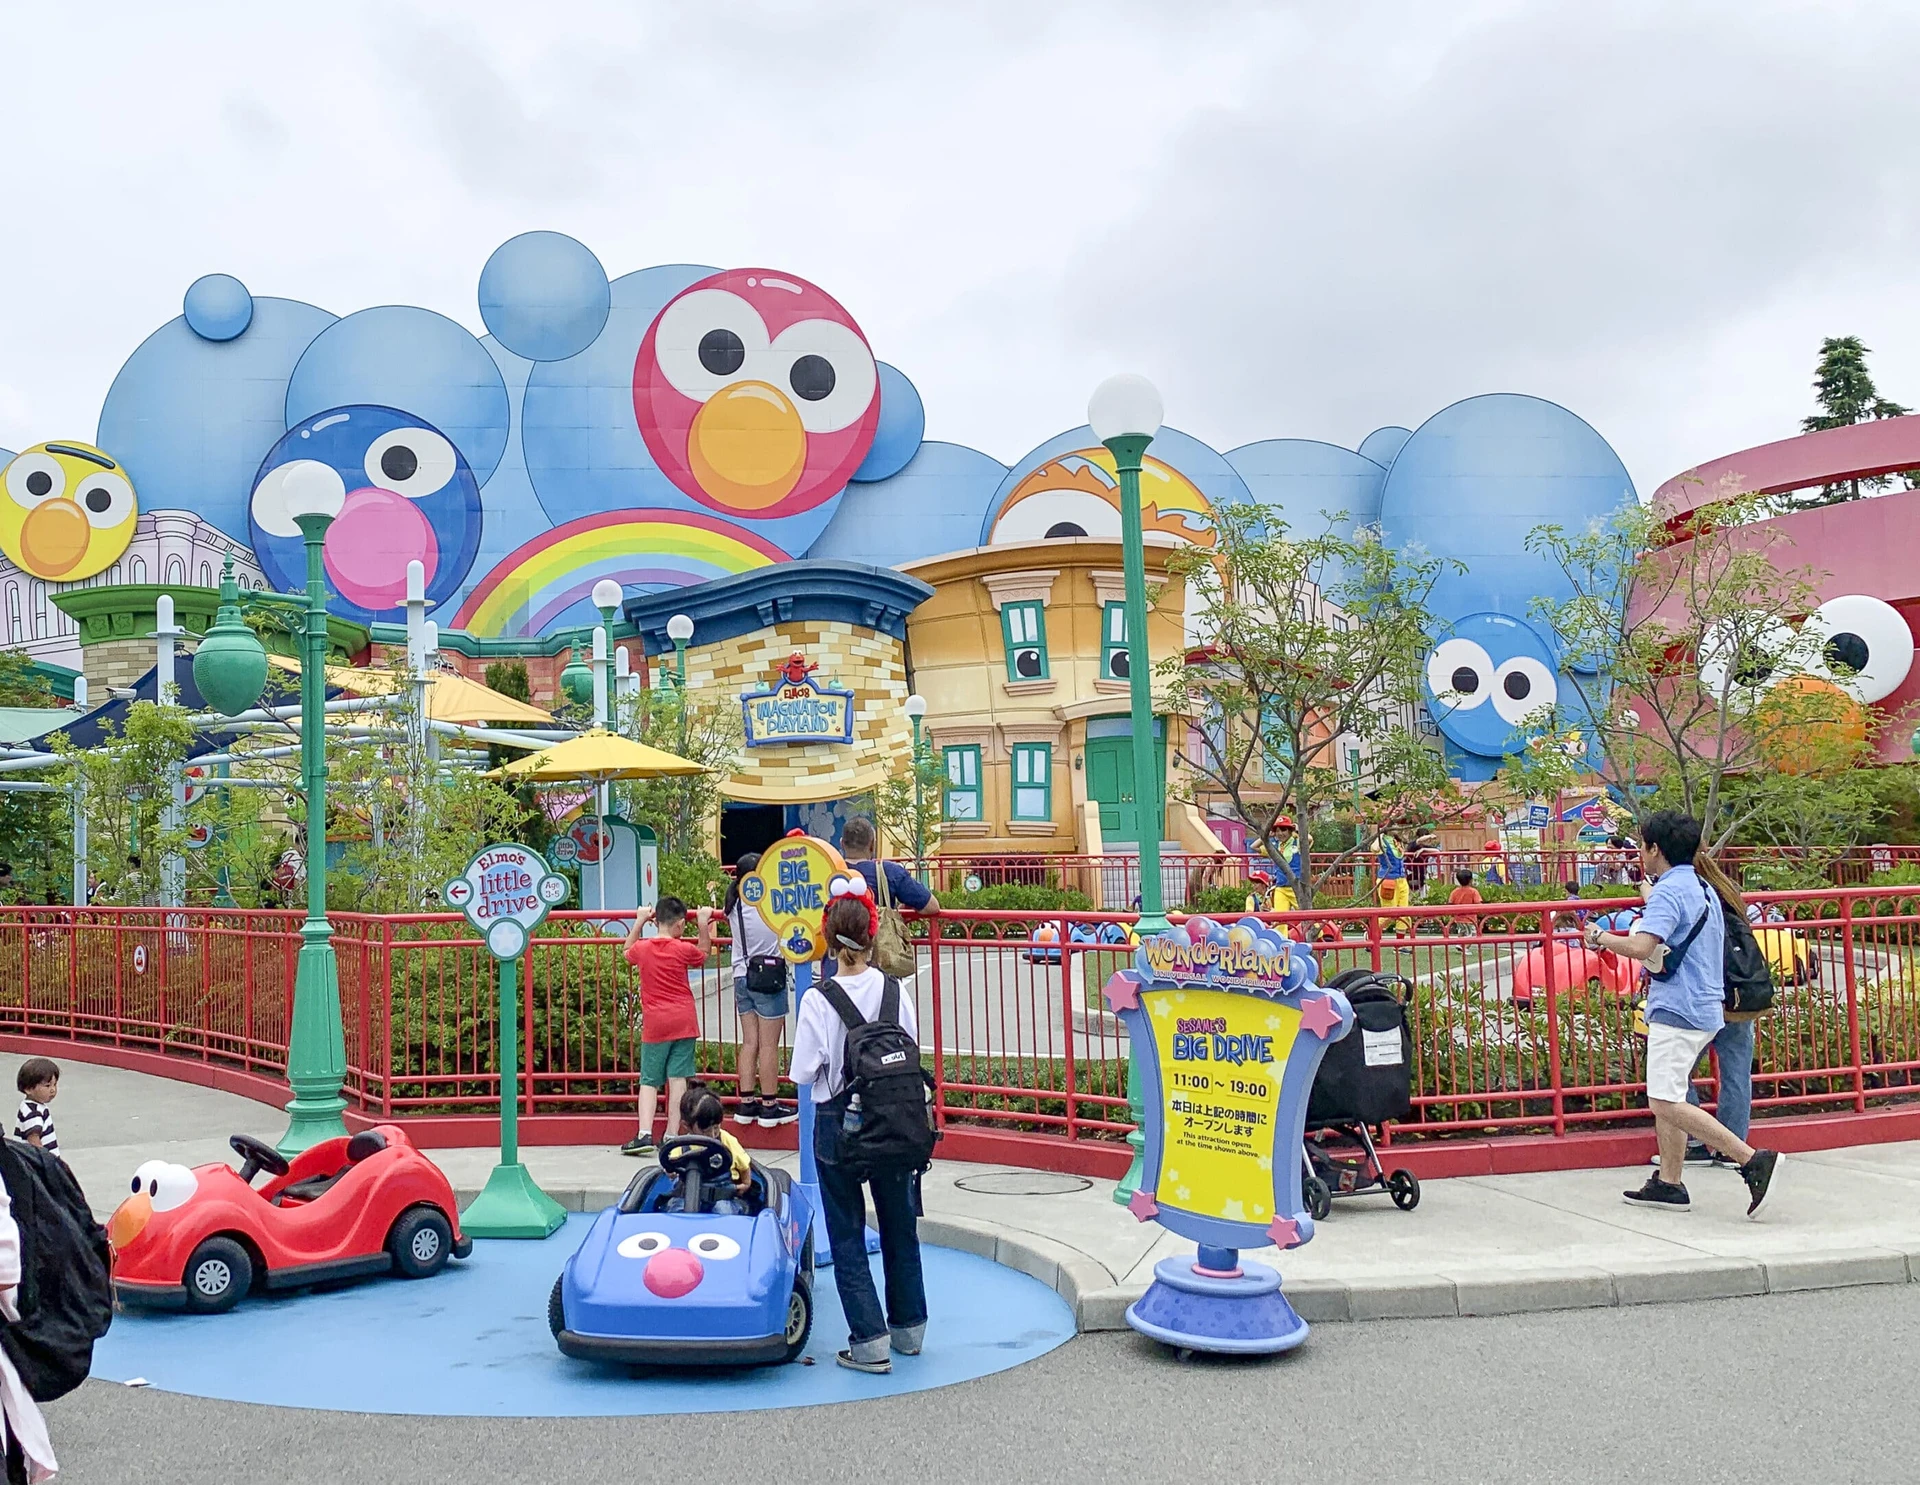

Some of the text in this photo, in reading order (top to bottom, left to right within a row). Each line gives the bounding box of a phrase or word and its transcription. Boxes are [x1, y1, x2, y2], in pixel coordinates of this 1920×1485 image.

[757, 699, 837, 720] IMAGINATION
[767, 715, 829, 735] PLAYLAND
[477, 852, 527, 871] Elmo's
[479, 870, 533, 896] little
[778, 860, 810, 886] BIG
[545, 881, 560, 890] Age
[545, 890, 560, 898] 3-5
[477, 893, 539, 918] drive
[770, 883, 824, 916] DRIVE
[1153, 969, 1282, 990] UNIVERSAL WONDERLAND
[1173, 1033, 1274, 1066] BIG DRIVE
[1173, 1073, 1209, 1089] 11:00
[1230, 1080, 1267, 1097] 19:00
[1172, 1099, 1268, 1125] 本日は上記の時間に
[1183, 1116, 1254, 1137] オープンします
[1183, 1131, 1252, 1150] This attraction opens
[1185, 1139, 1196, 1147] the
[1197, 1141, 1213, 1150] time
[1214, 1145, 1237, 1155] shown
[1237, 1148, 1260, 1159] above.
